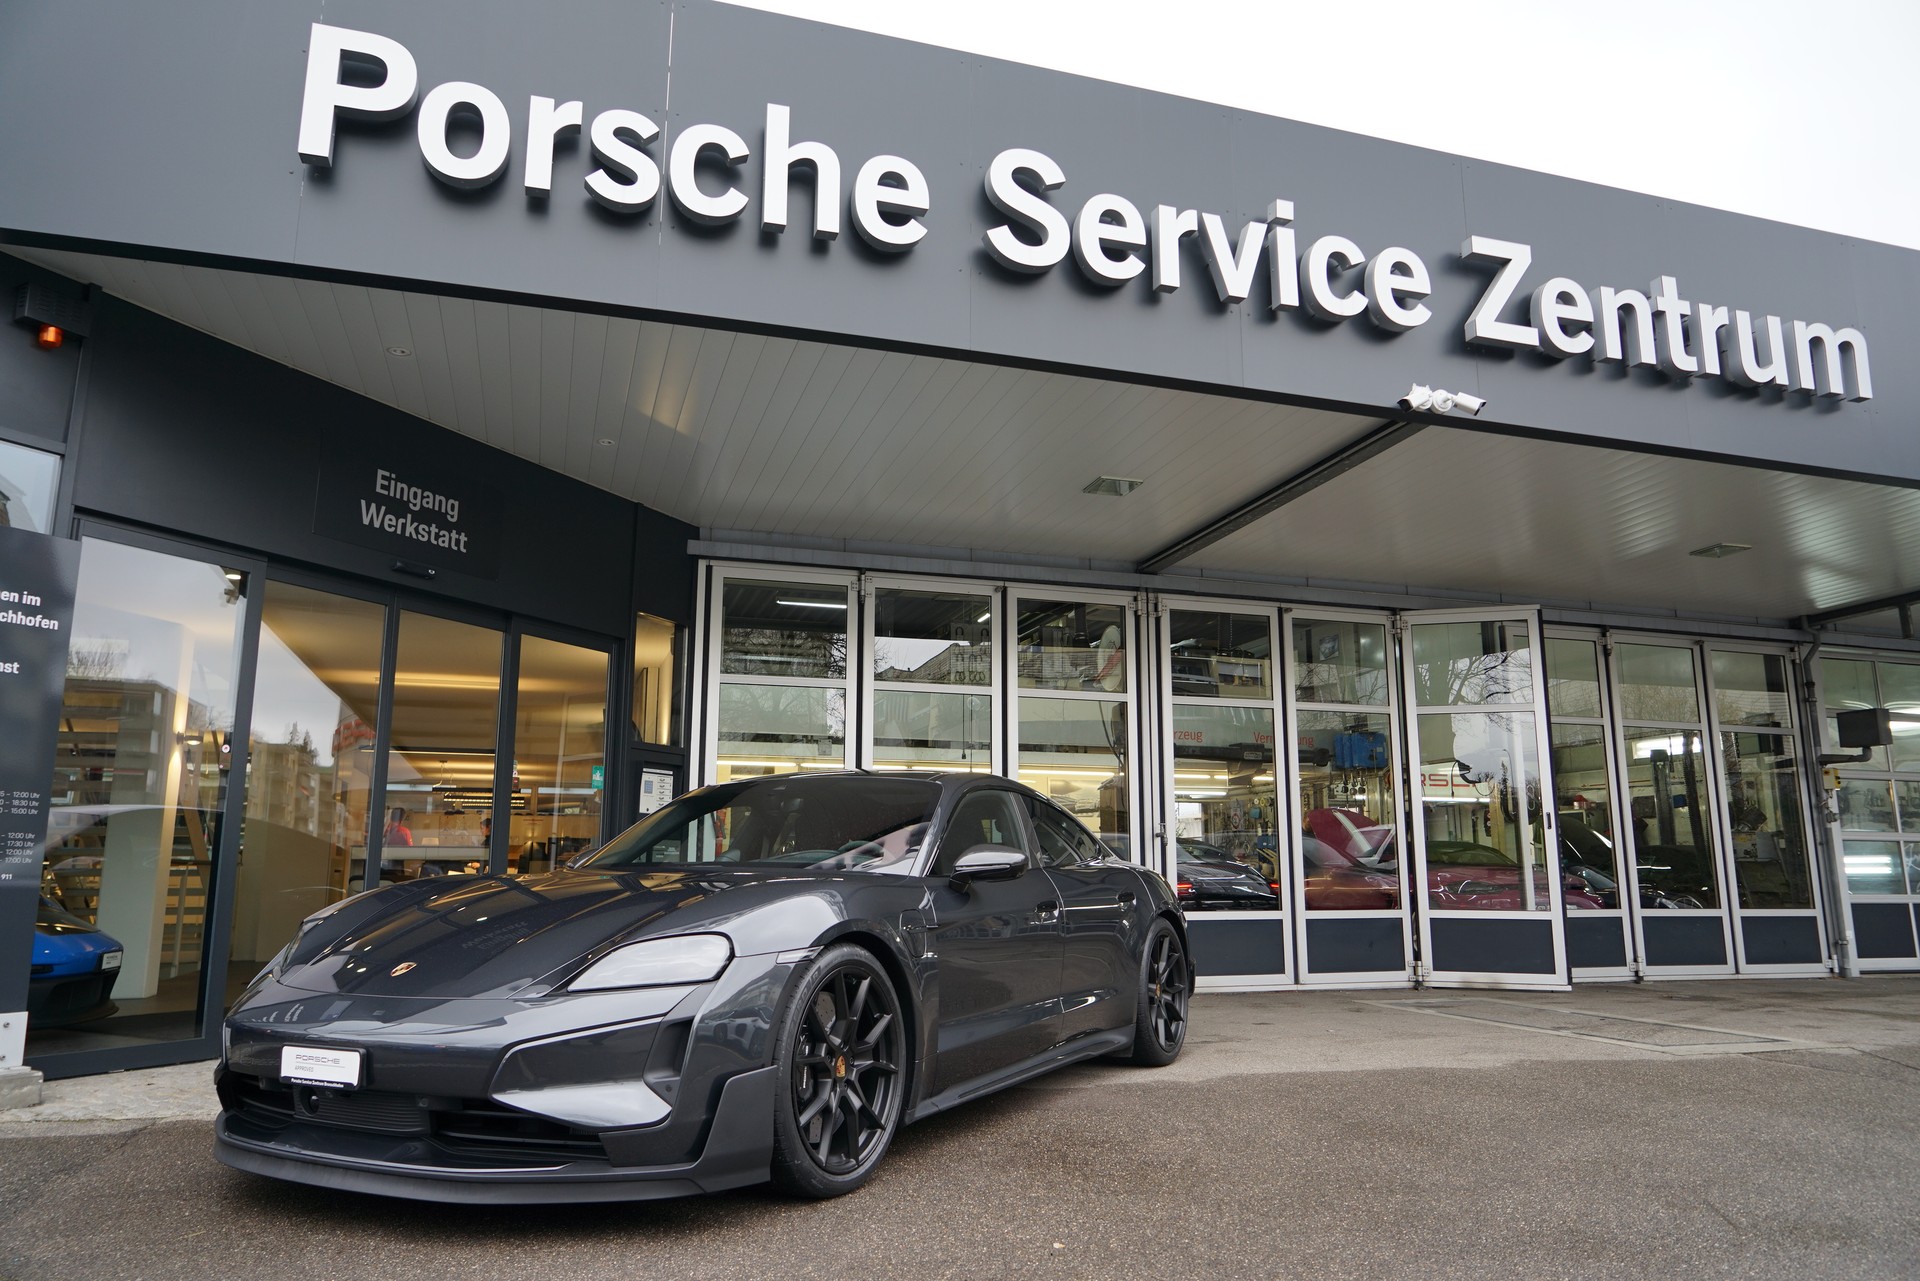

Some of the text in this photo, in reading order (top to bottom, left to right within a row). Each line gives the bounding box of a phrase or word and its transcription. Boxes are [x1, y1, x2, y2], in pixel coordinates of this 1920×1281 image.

[298, 22, 1872, 403] Porsche Service Zentrum
[375, 468, 460, 523] Eingang
[360, 499, 468, 553] Werkstatt
[0, 590, 41, 606] en im
[0, 610, 59, 630] chhofen
[296, 1054, 340, 1065] PORSCHE
